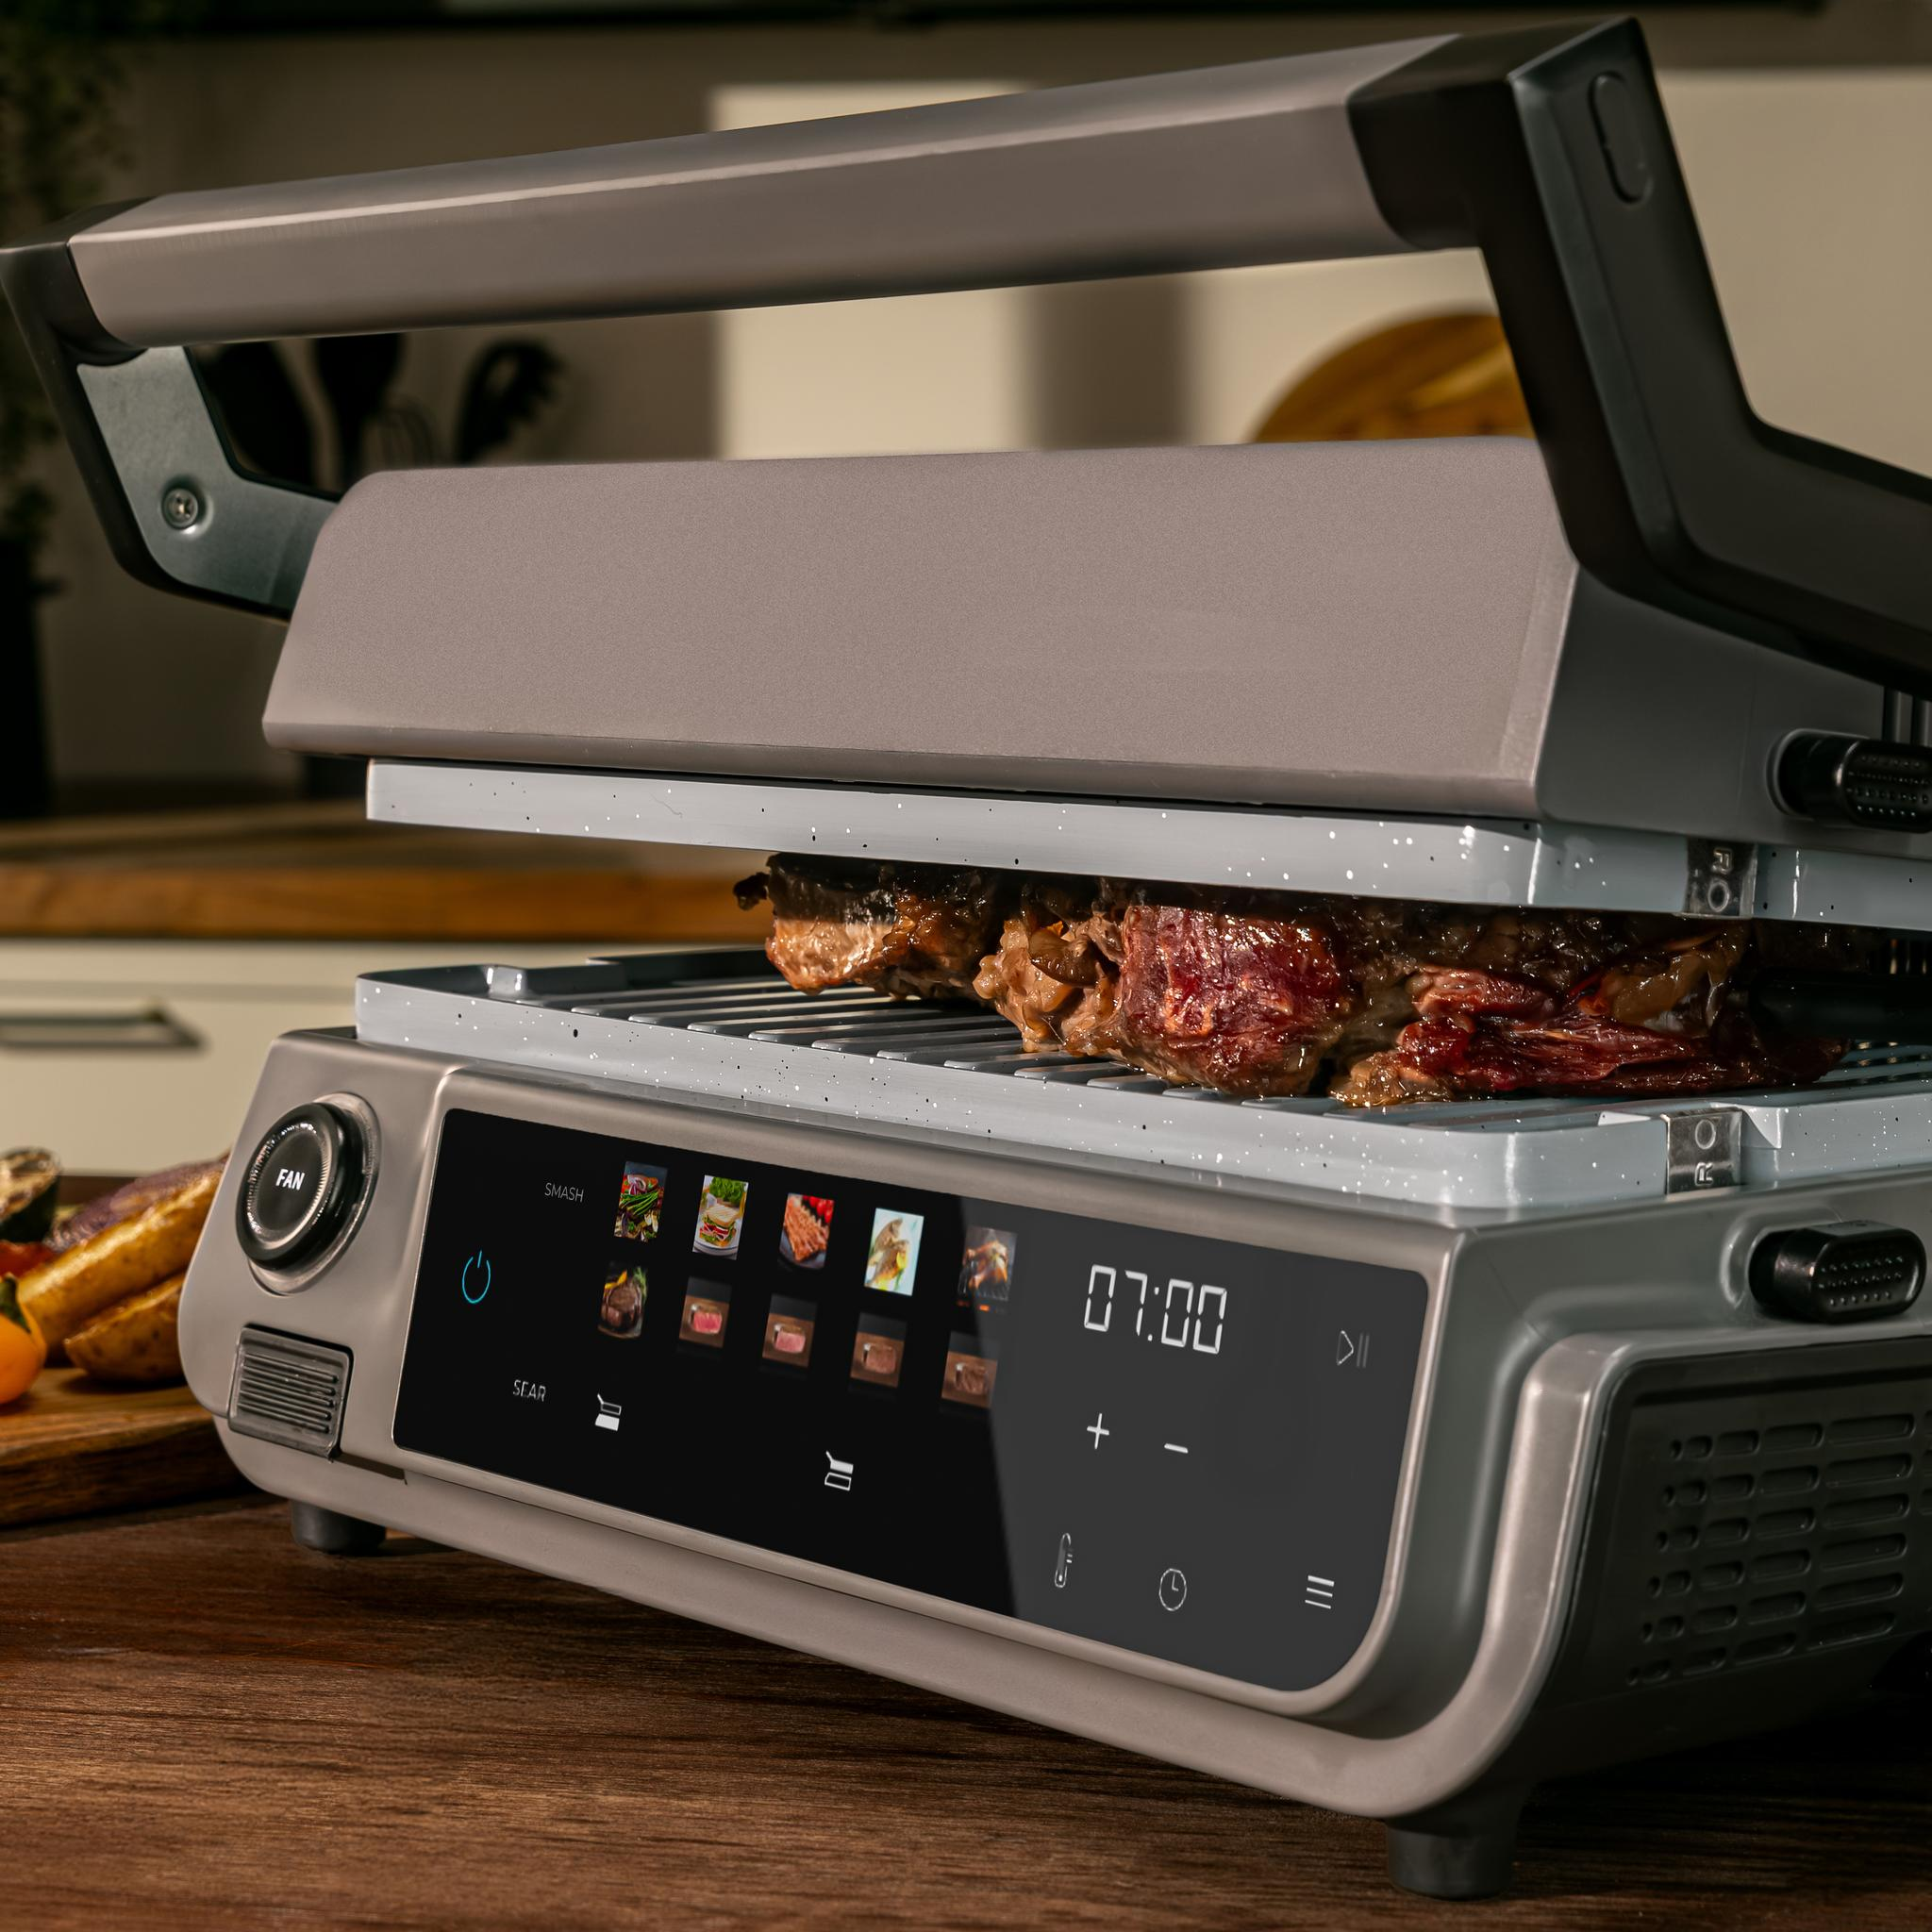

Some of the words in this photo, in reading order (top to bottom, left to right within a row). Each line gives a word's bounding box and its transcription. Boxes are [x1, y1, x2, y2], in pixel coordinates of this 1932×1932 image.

[275, 1168, 305, 1191] FAN
[544, 1182, 584, 1203] SMASH
[1084, 1264, 1226, 1354] 07:00
[512, 1379, 546, 1402] SEAR
